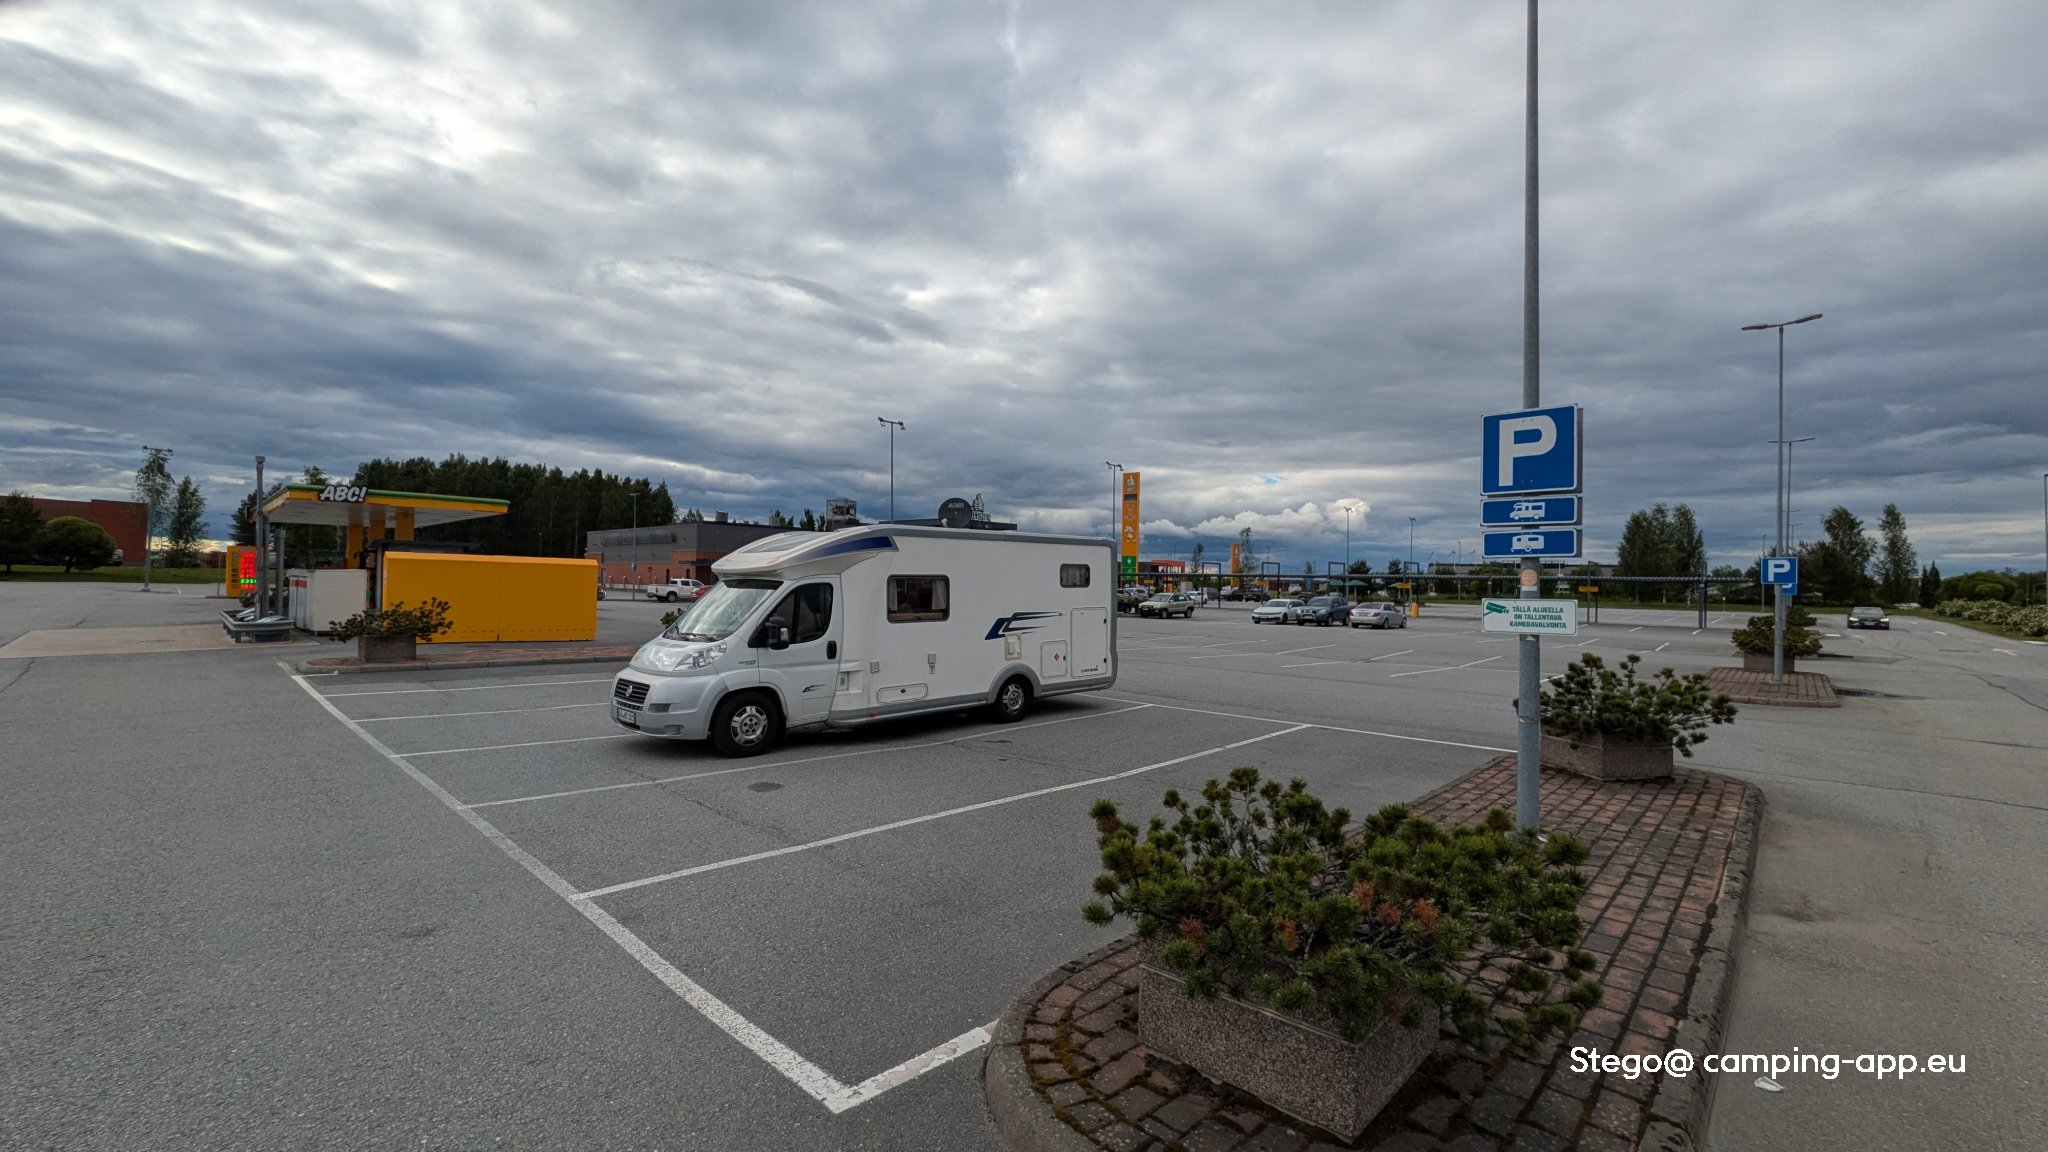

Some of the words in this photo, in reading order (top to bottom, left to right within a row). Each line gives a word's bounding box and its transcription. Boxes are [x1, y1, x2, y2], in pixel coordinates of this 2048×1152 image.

[1499, 415, 1557, 487] P
[320, 486, 367, 502] ABC!
[1768, 560, 1790, 581] P
